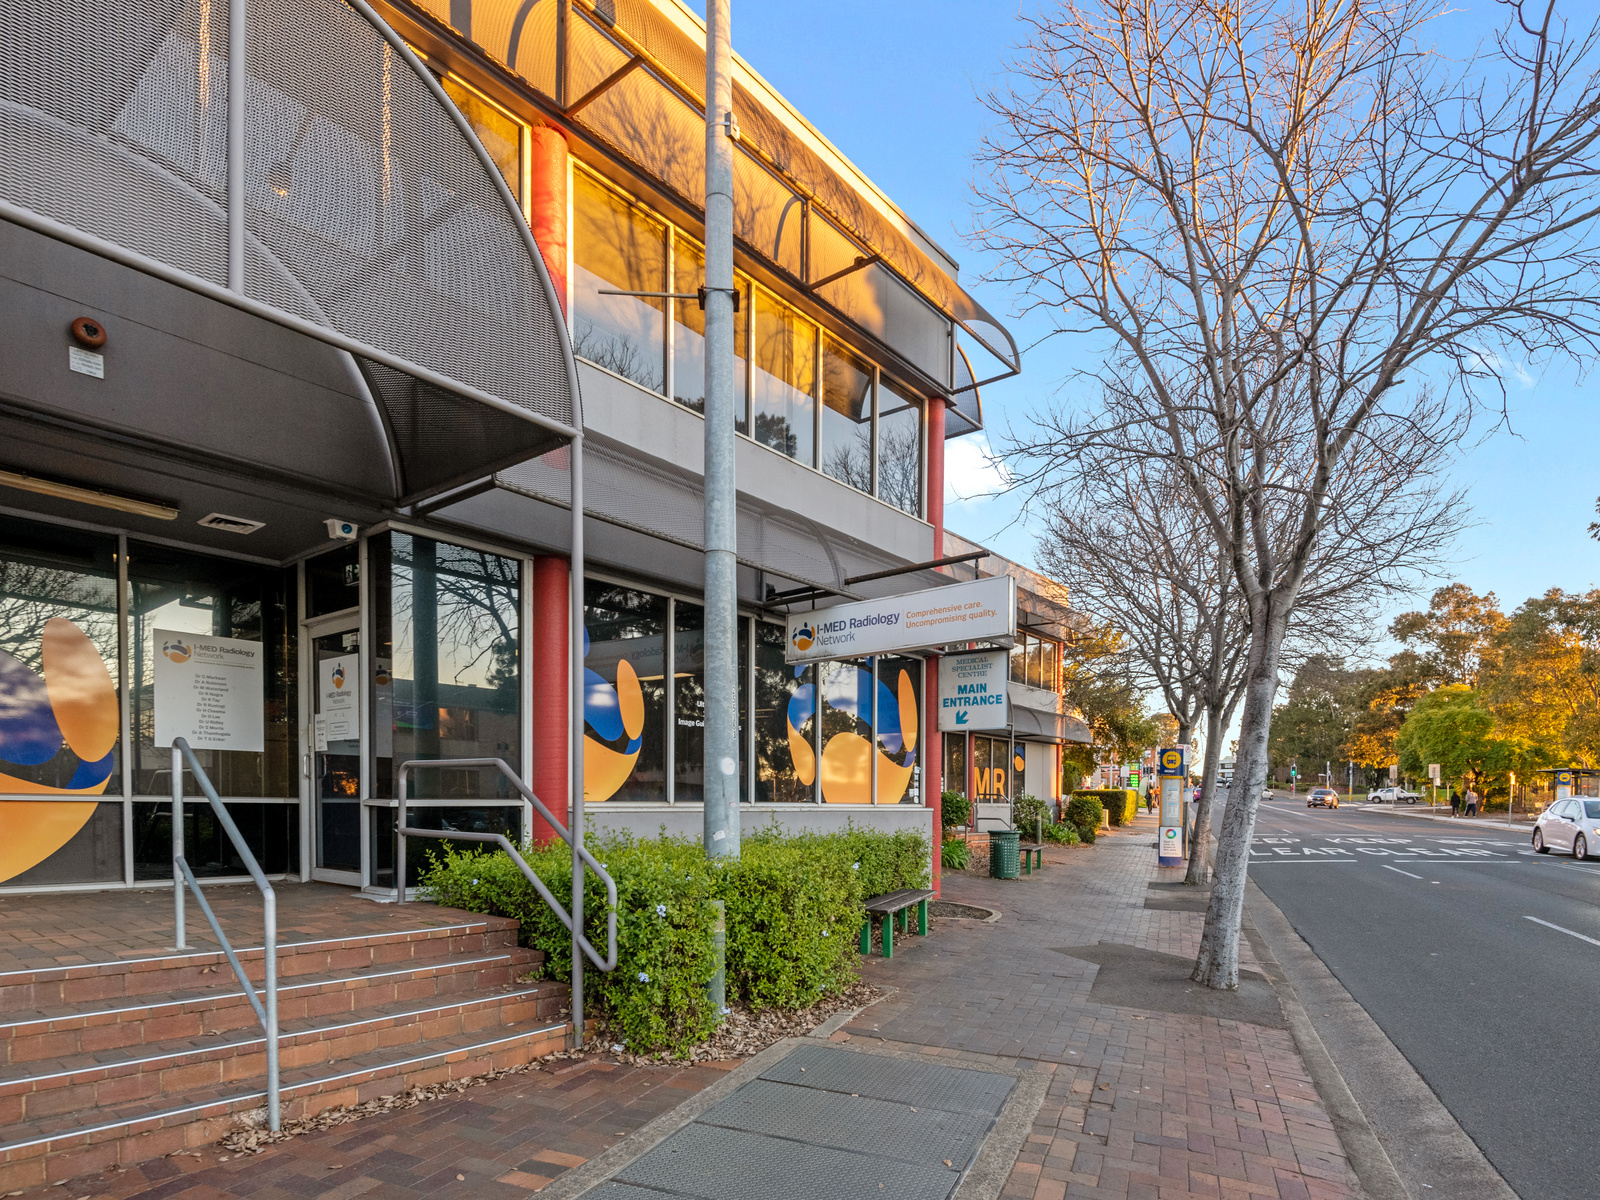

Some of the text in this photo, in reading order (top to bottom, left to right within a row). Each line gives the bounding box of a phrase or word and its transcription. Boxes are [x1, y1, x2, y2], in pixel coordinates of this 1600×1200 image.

[906, 601, 983, 619] Comprehensive care.
[816, 612, 900, 635] I-MED Radiology
[905, 609, 998, 629] Uncompromising quality.
[816, 631, 856, 647] Network
[193, 644, 256, 658] I-MED Radiology
[193, 650, 225, 660] Network
[956, 656, 989, 665] MEDICAL
[951, 662, 994, 672] SPECIALIST
[957, 670, 988, 679] CENTRE
[957, 683, 987, 695] MAIN
[942, 694, 1003, 708] ENTRANCE
[678, 718, 695, 727] Image
[974, 766, 1012, 799] MR
[1250, 847, 1355, 855] LEAR
[1356, 847, 1509, 857] CLEAR
